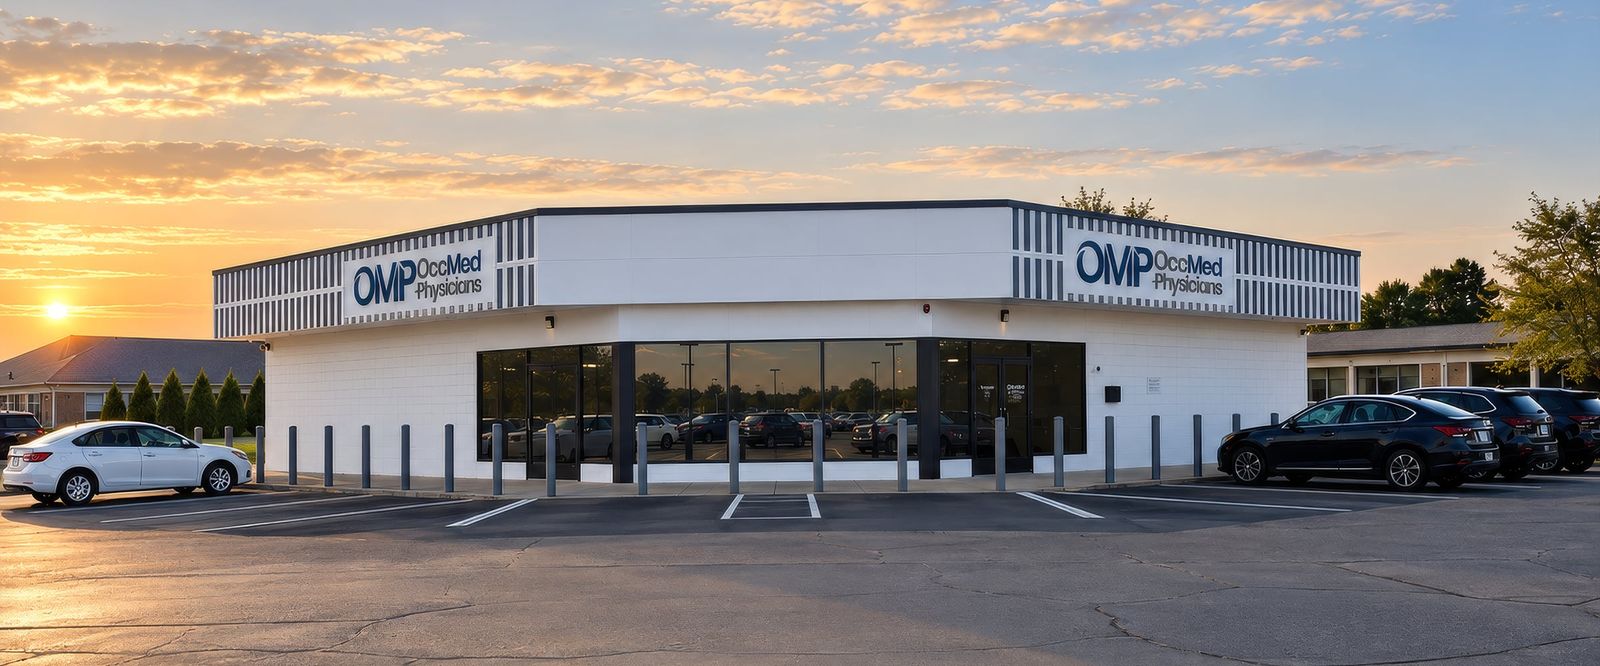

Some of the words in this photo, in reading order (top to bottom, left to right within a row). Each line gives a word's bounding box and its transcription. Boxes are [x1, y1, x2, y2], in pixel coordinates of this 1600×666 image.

[417, 249, 482, 279] OccMed
[1076, 240, 1154, 287] OMP
[1154, 250, 1223, 277] OccMed
[354, 259, 417, 306] OMP
[415, 277, 482, 302] Physicians
[1152, 273, 1223, 296] Physicians
